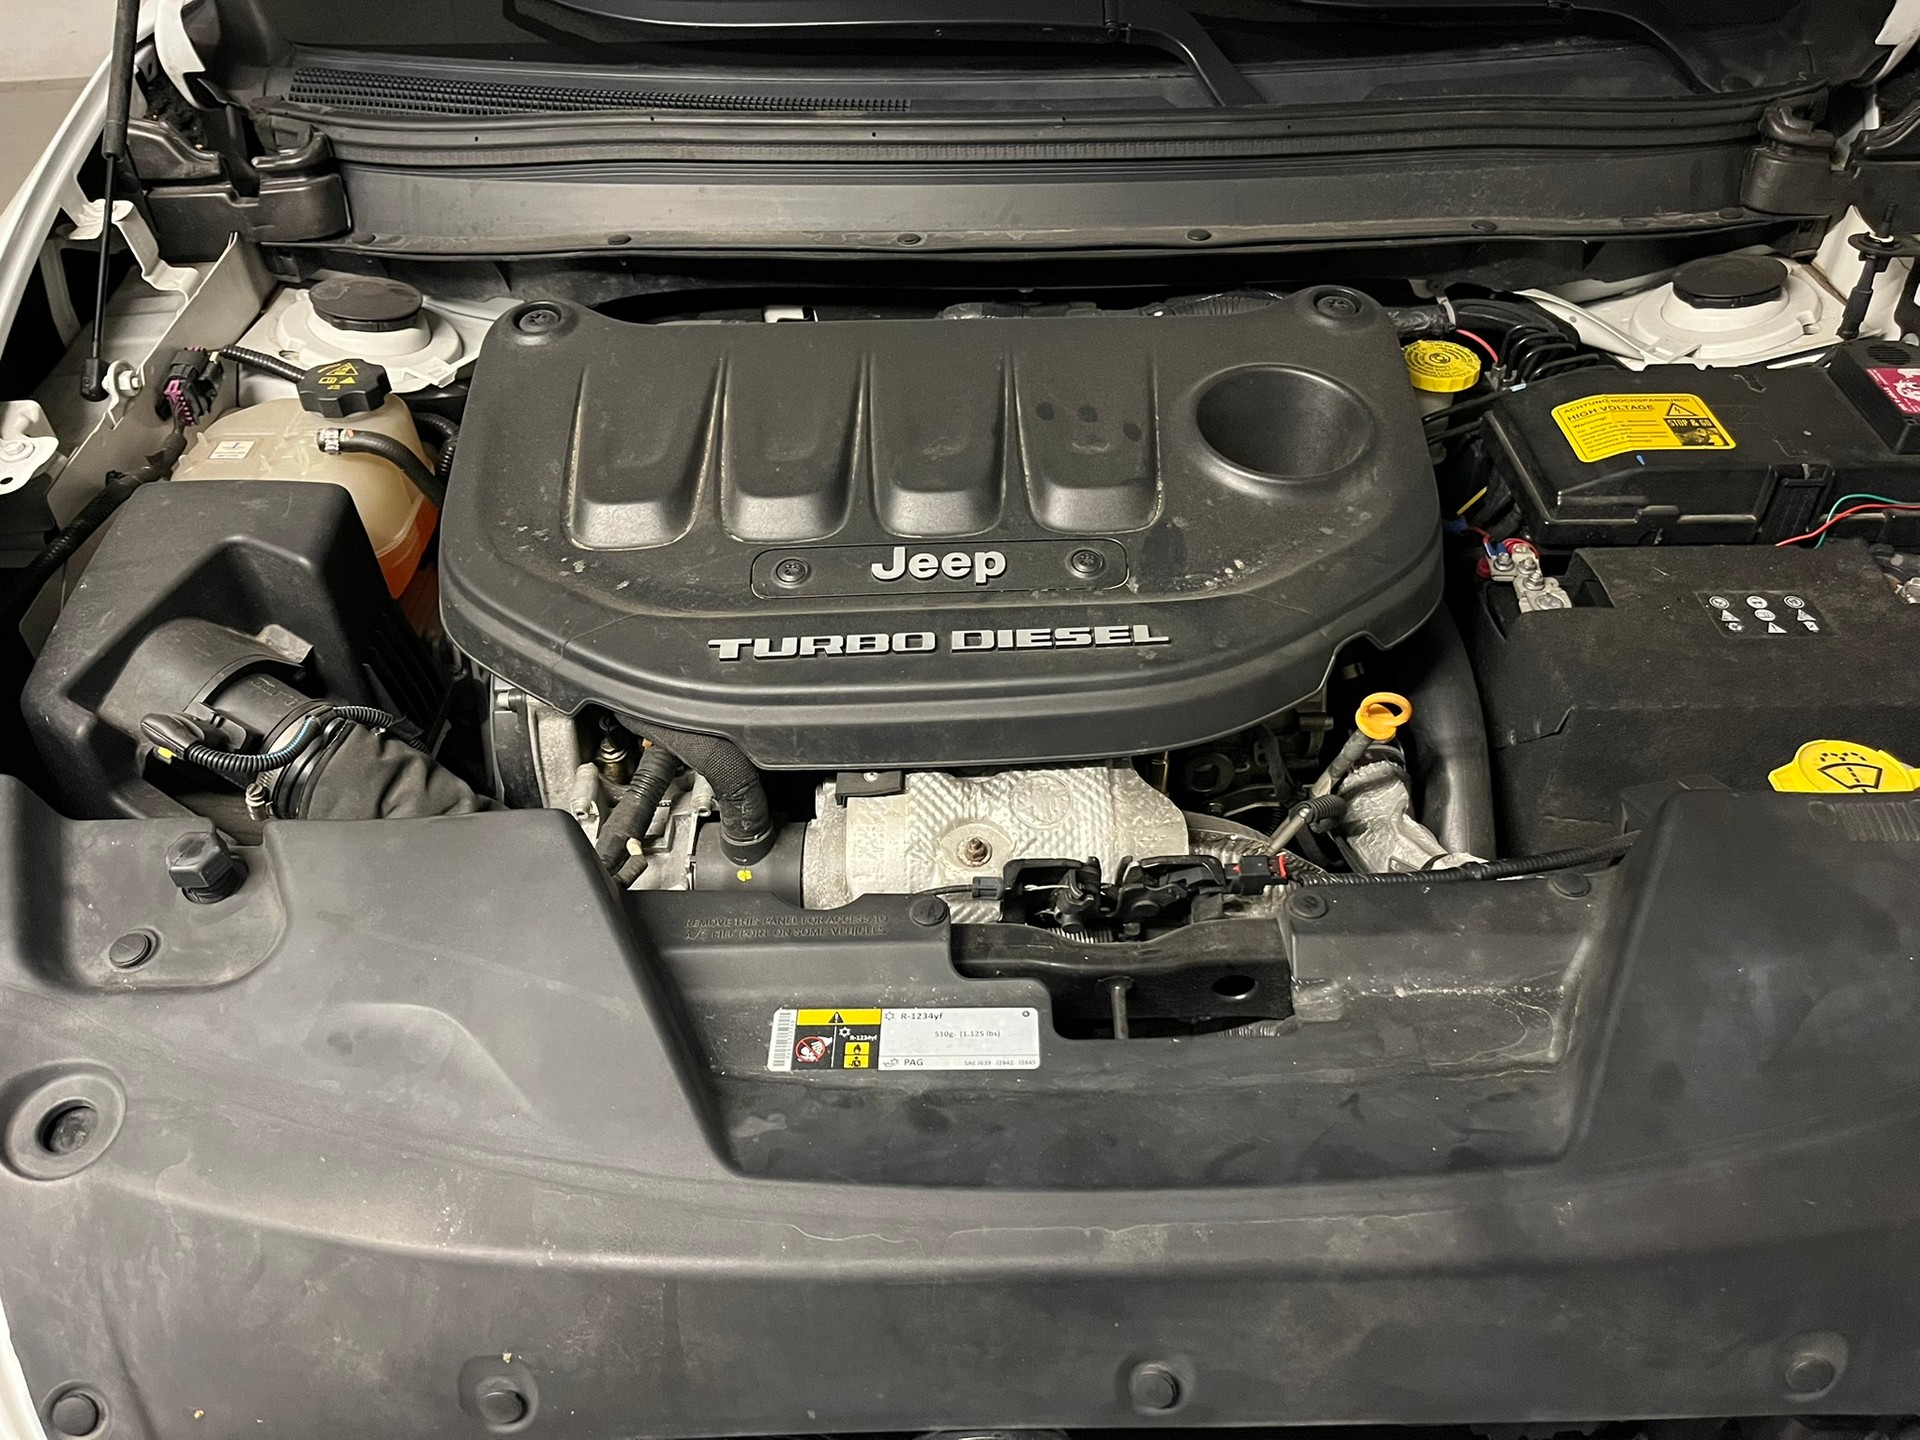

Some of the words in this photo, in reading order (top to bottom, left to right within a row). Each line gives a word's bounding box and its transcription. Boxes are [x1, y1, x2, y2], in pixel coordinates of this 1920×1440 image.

[1567, 409, 1598, 421] HIGH
[1600, 404, 1654, 412] VOLTAGE
[1668, 419, 1689, 427] STOP
[1690, 419, 1700, 427] &
[1701, 419, 1712, 427] GO
[871, 546, 1006, 584] Jeep
[708, 632, 937, 660] TURBO
[951, 624, 1170, 652] DIESEL
[685, 918, 732, 927] REMOVE
[734, 918, 761, 926] THIS
[763, 916, 798, 926] PANEL
[802, 916, 823, 925] FOR
[826, 916, 870, 924] ACCESS
[873, 915, 889, 924] TO
[685, 929, 707, 939] A/C
[711, 929, 737, 938] FILL
[739, 929, 769, 938] PORT
[773, 928, 792, 937] ON
[794, 928, 826, 936] SOME
[831, 926, 889, 936] VEHICLES
[901, 1012, 943, 1021] R-1234yf
[959, 1030, 984, 1038] (1.125
[986, 1030, 1001, 1038] lbs)
[904, 1058, 924, 1066] PAG
